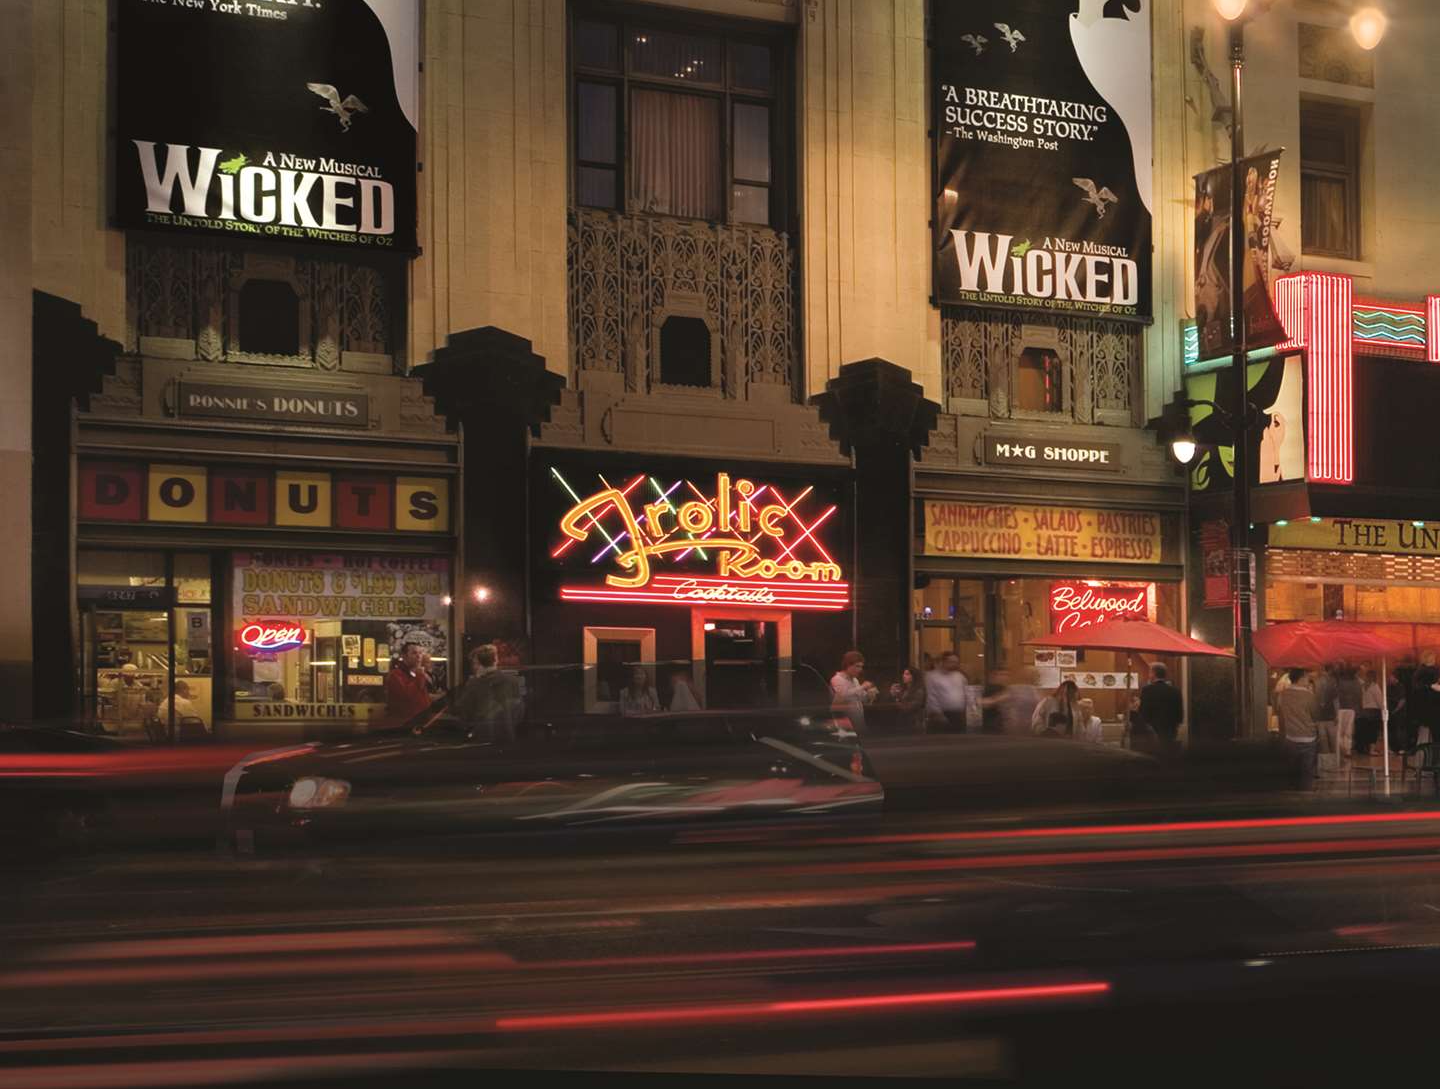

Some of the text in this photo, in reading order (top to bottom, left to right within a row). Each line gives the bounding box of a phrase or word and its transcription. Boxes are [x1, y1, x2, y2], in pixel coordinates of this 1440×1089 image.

[245, 2, 288, 20] Times
[965, 87, 1108, 123] BREATHTAKING
[945, 106, 1028, 133] SUCCESS
[976, 130, 1035, 149] Washington
[1037, 137, 1059, 151] Post
[262, 151, 277, 167] A
[1261, 158, 1280, 247] HOLLYWOOD
[264, 224, 279, 235] OF
[1042, 238, 1052, 251] A
[273, 397, 358, 417] DONUTS
[1043, 447, 1109, 464] SHOPPE
[95, 473, 439, 520] DONUTS
[560, 472, 789, 588] Frolic
[931, 503, 1156, 536] SANDWICHES SALADS PASTRIES
[934, 530, 1152, 559] CAPPUCCINO LATTE ESPRESSO
[1332, 520, 1386, 547] THE
[720, 549, 842, 582] Room
[243, 568, 325, 592] DONUTS
[673, 580, 778, 604] Cocktails
[242, 594, 425, 616] SANDWICHES
[1052, 587, 1144, 612] Belwood
[241, 625, 302, 649] Open
[253, 703, 355, 718] SANDWICHES
